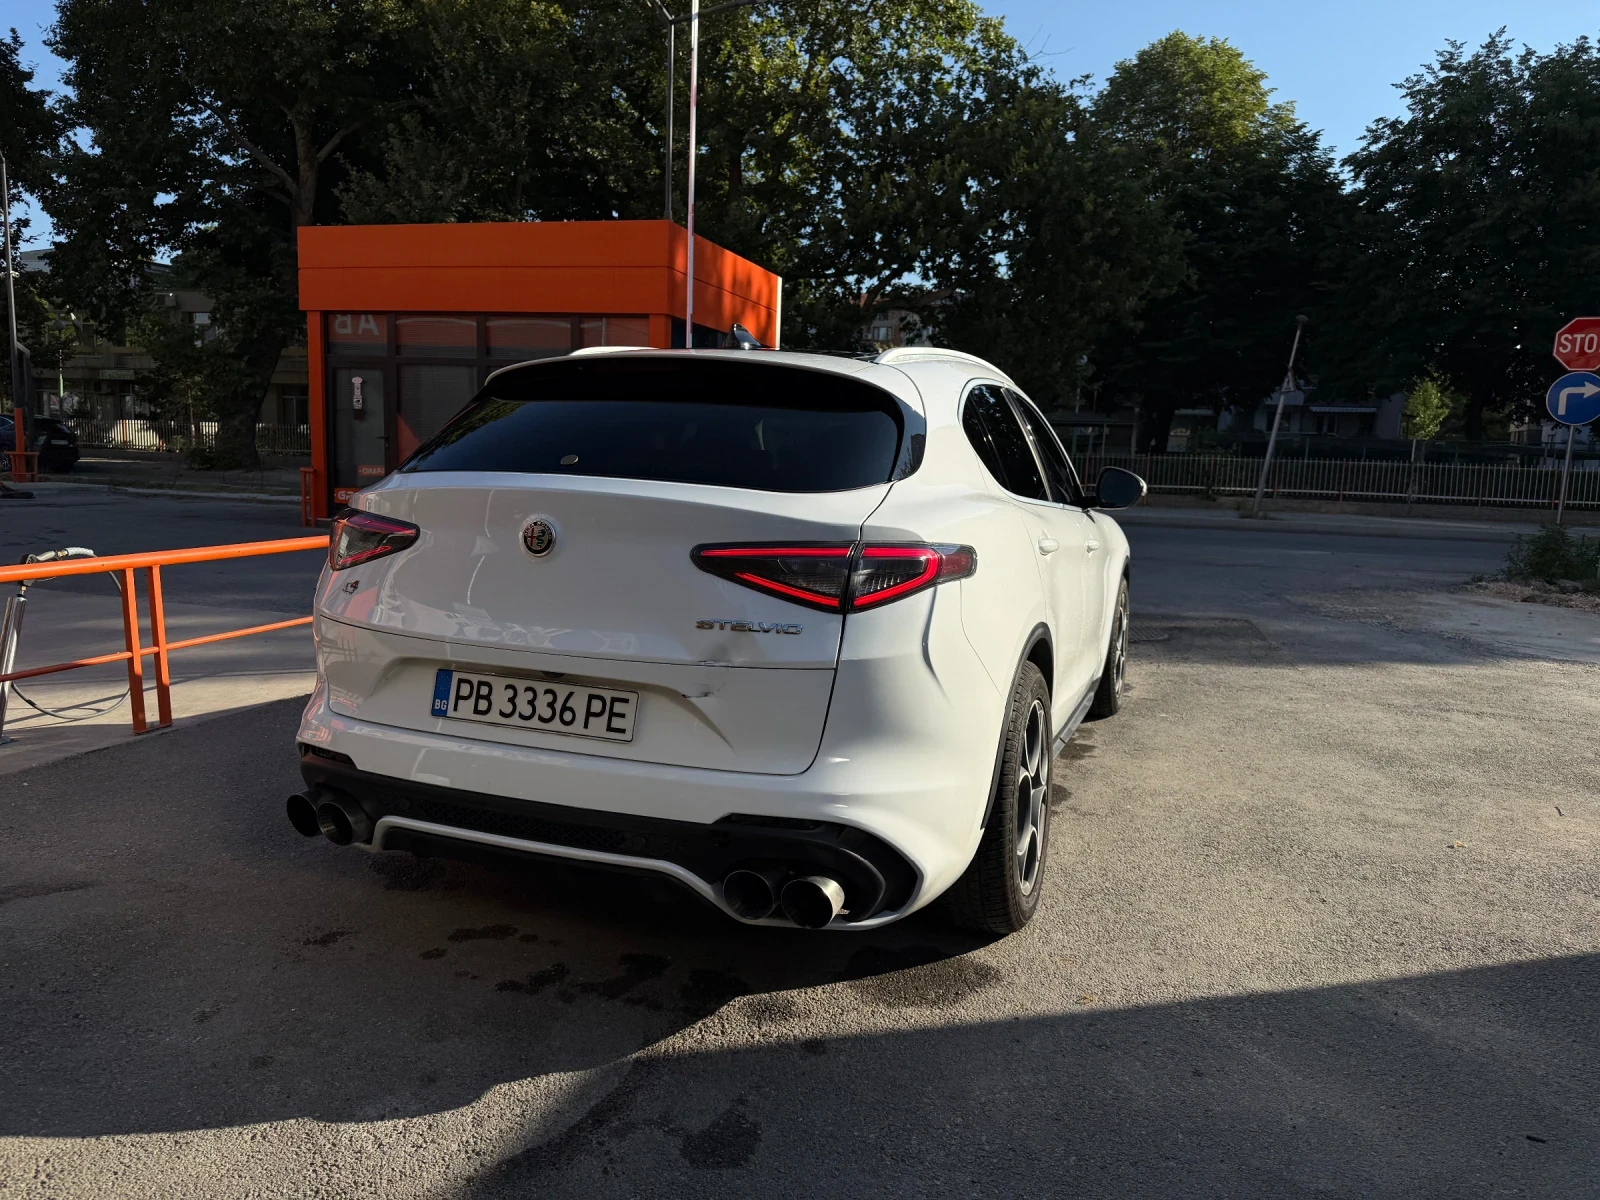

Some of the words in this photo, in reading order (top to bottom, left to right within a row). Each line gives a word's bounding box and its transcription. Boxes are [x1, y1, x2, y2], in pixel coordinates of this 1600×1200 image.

[1558, 334, 1600, 354] STO
[695, 618, 803, 635] STELVIO
[434, 698, 448, 711] BG
[453, 677, 493, 716] PB
[498, 684, 577, 727] 3336
[583, 693, 630, 734] PE
